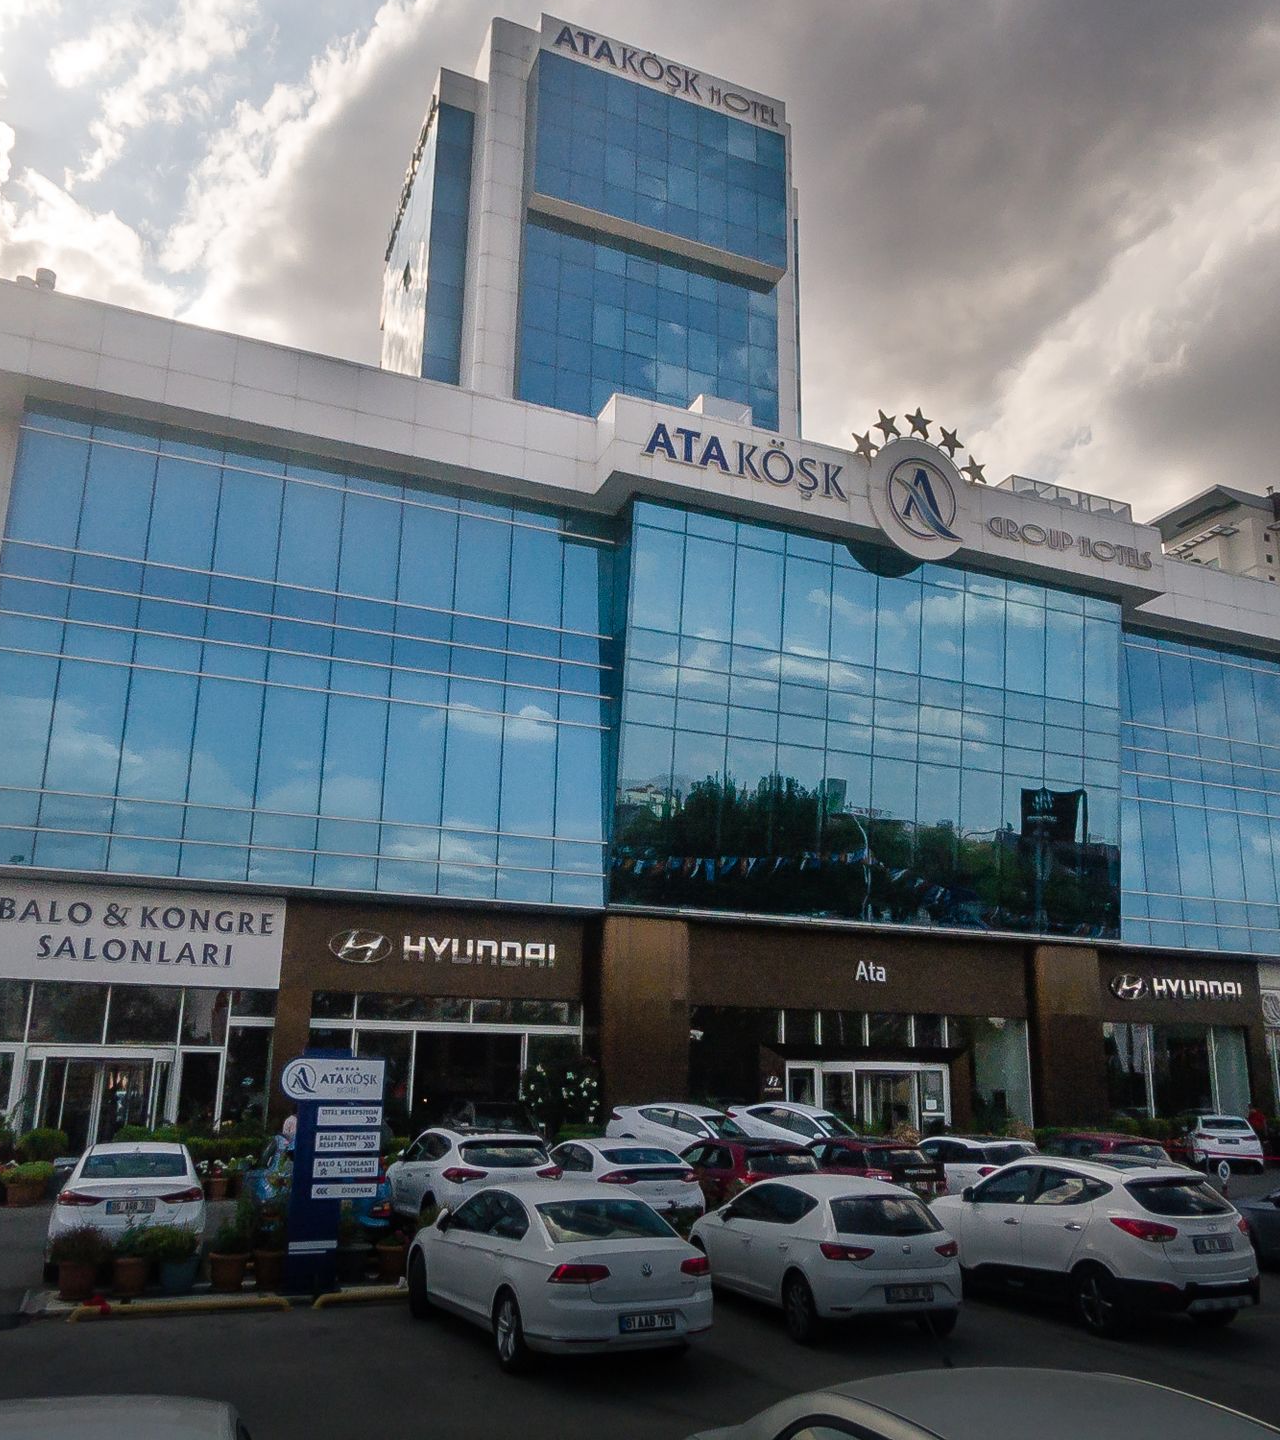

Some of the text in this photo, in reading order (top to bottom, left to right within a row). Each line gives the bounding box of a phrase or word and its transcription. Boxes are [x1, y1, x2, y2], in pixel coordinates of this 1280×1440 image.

[708, 84, 779, 128] HOTEL
[641, 423, 848, 501] ATAKÖŞK
[987, 516, 1153, 570] GROUP HOTELS
[102, 902, 131, 927] &
[140, 905, 274, 935] KONGRE
[36, 934, 233, 967] SALONLARI
[403, 935, 556, 968] HYUNDAI
[855, 960, 886, 982] Ata
[1152, 978, 1242, 999] HYUNDAI
[341, 1186, 373, 1194] OTOPARK
